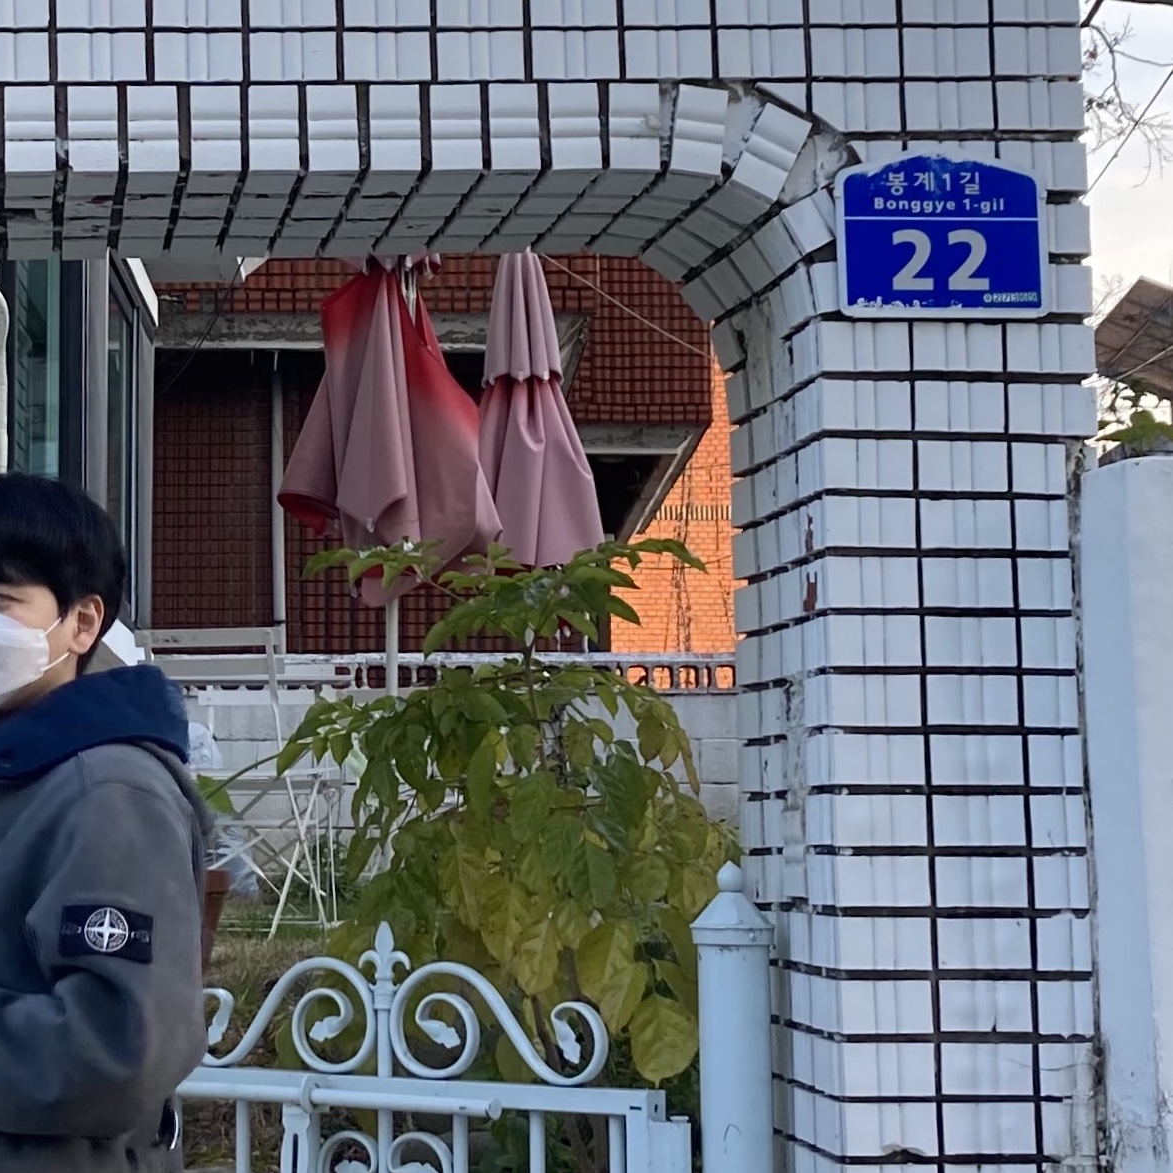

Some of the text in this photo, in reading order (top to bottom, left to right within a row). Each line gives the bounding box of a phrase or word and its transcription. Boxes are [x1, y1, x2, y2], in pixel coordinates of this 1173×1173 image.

[885, 171, 981, 196] 봉계1길
[873, 197, 1005, 214] Bonggye 1-gil
[892, 229, 990, 291] 22
